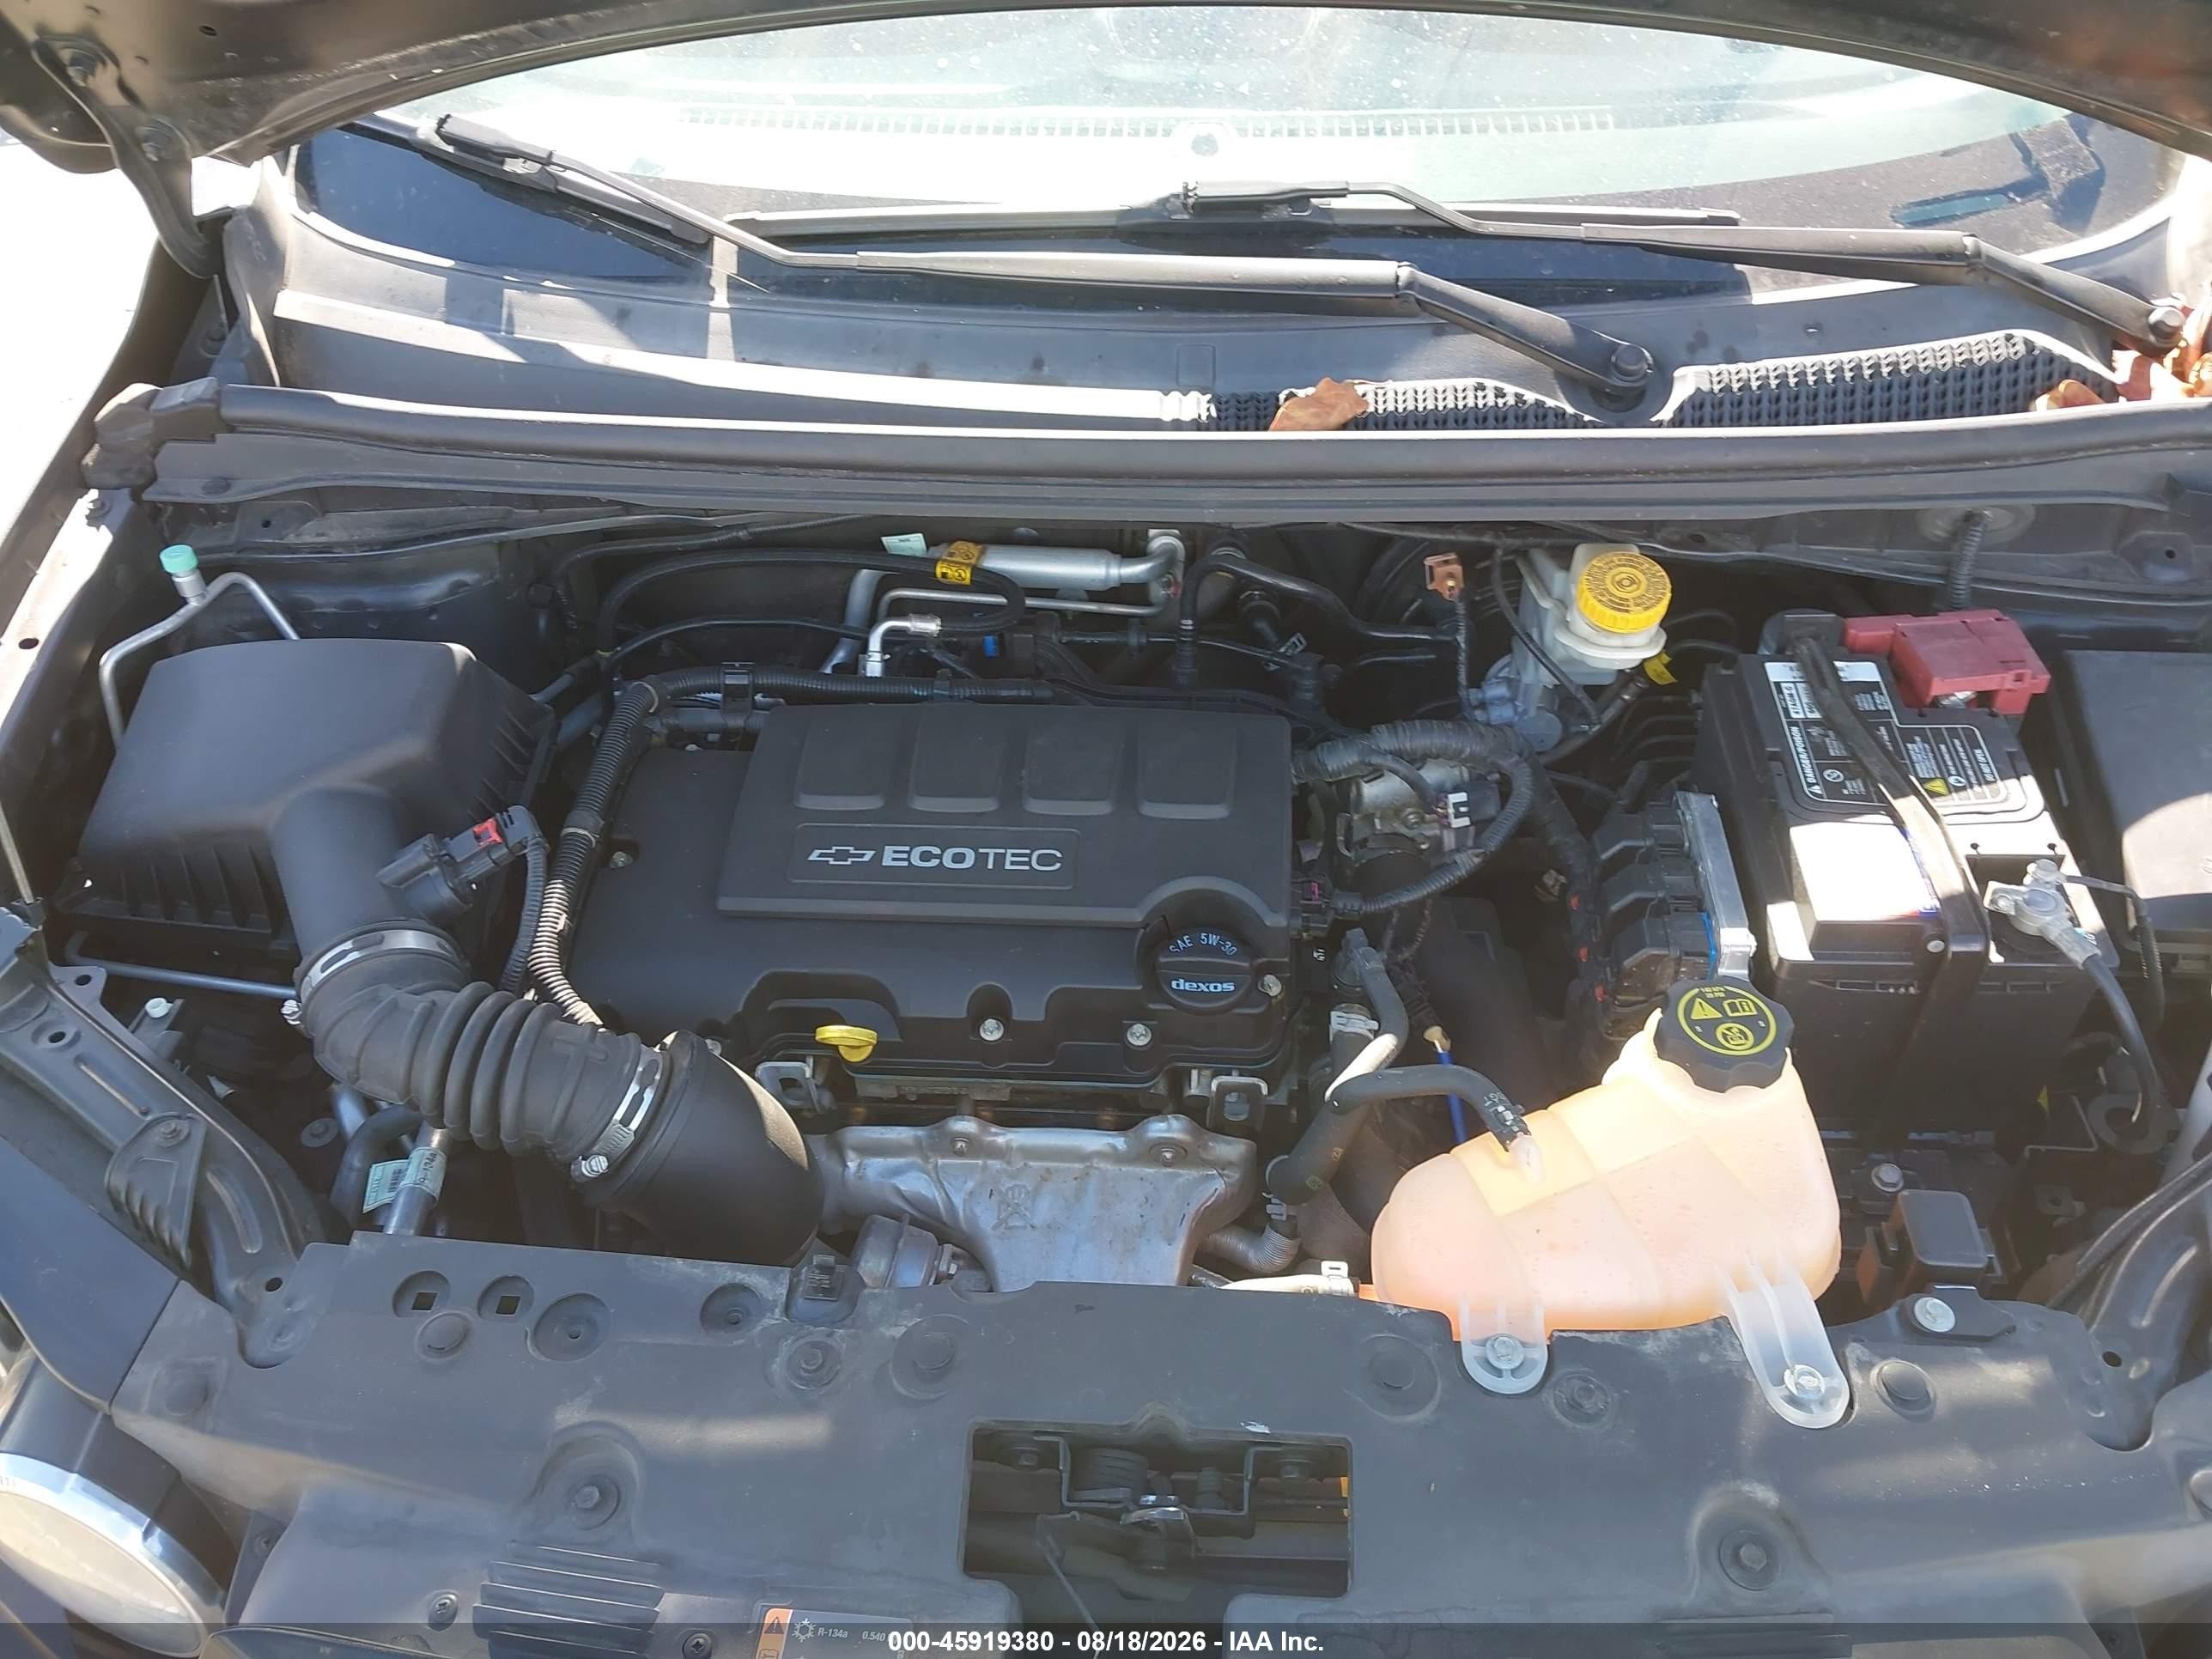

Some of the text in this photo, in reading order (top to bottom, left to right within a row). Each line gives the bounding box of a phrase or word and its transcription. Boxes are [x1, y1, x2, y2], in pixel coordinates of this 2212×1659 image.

[1790, 726, 1817, 783] DANGER/POISON
[881, 846, 1063, 871] ECOTEC
[1169, 933, 1237, 956] SAE 5W-30
[1171, 979, 1235, 993] dexos
[817, 1627, 848, 1638] R-134a
[861, 1631, 886, 1642] 0.540
